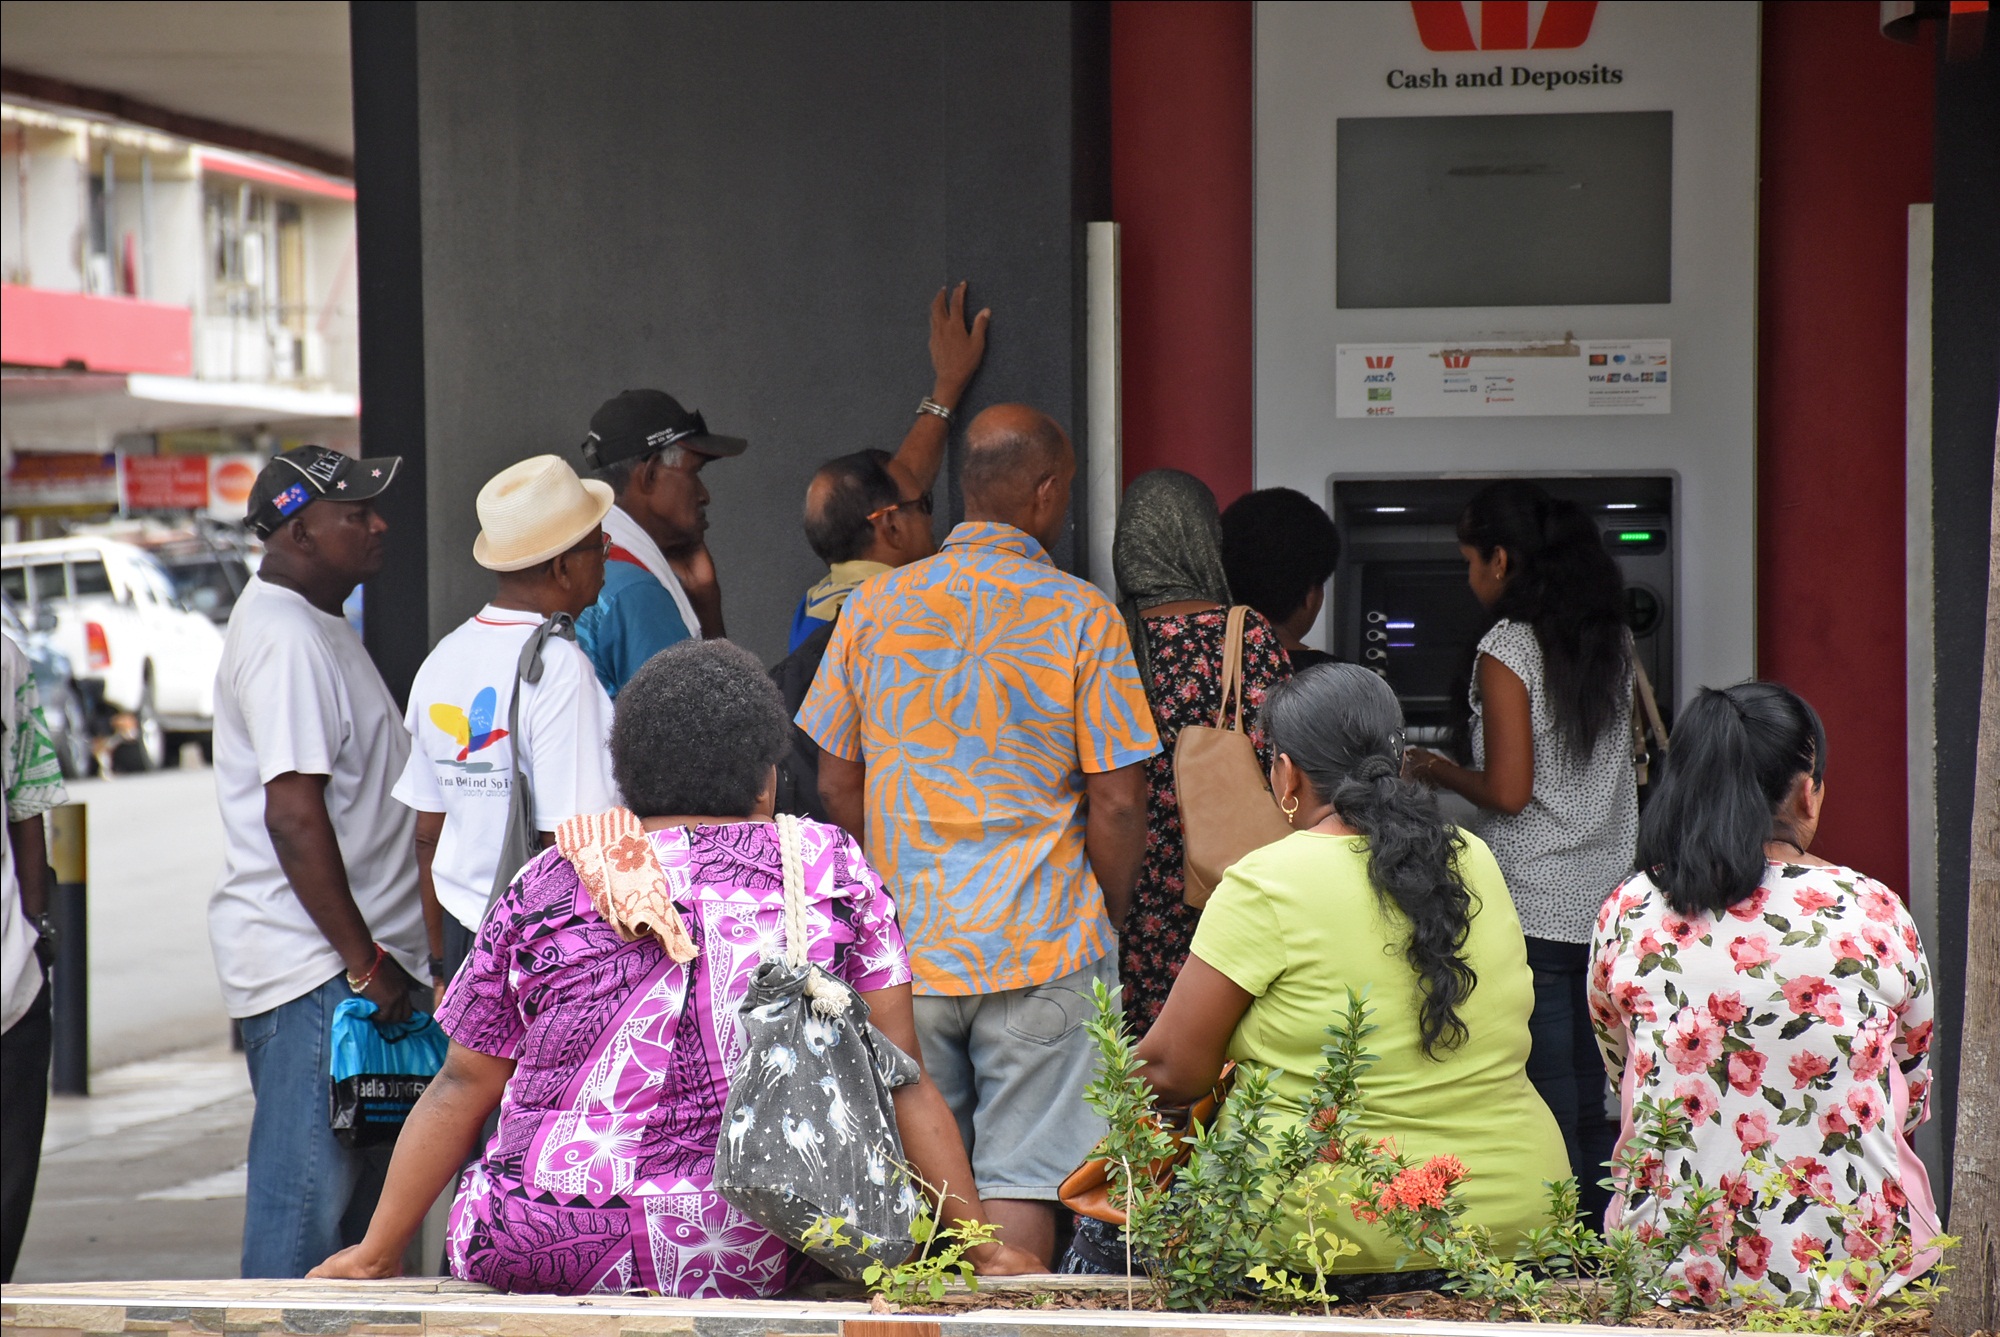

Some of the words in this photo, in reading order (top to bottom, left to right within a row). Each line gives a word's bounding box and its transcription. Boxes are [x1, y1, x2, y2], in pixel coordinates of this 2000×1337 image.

[1386, 68, 1448, 89] Cash
[1455, 66, 1503, 87] and
[1511, 64, 1623, 91] Deposits
[1588, 375, 1606, 383] VISA
[359, 1078, 386, 1098] aelia
